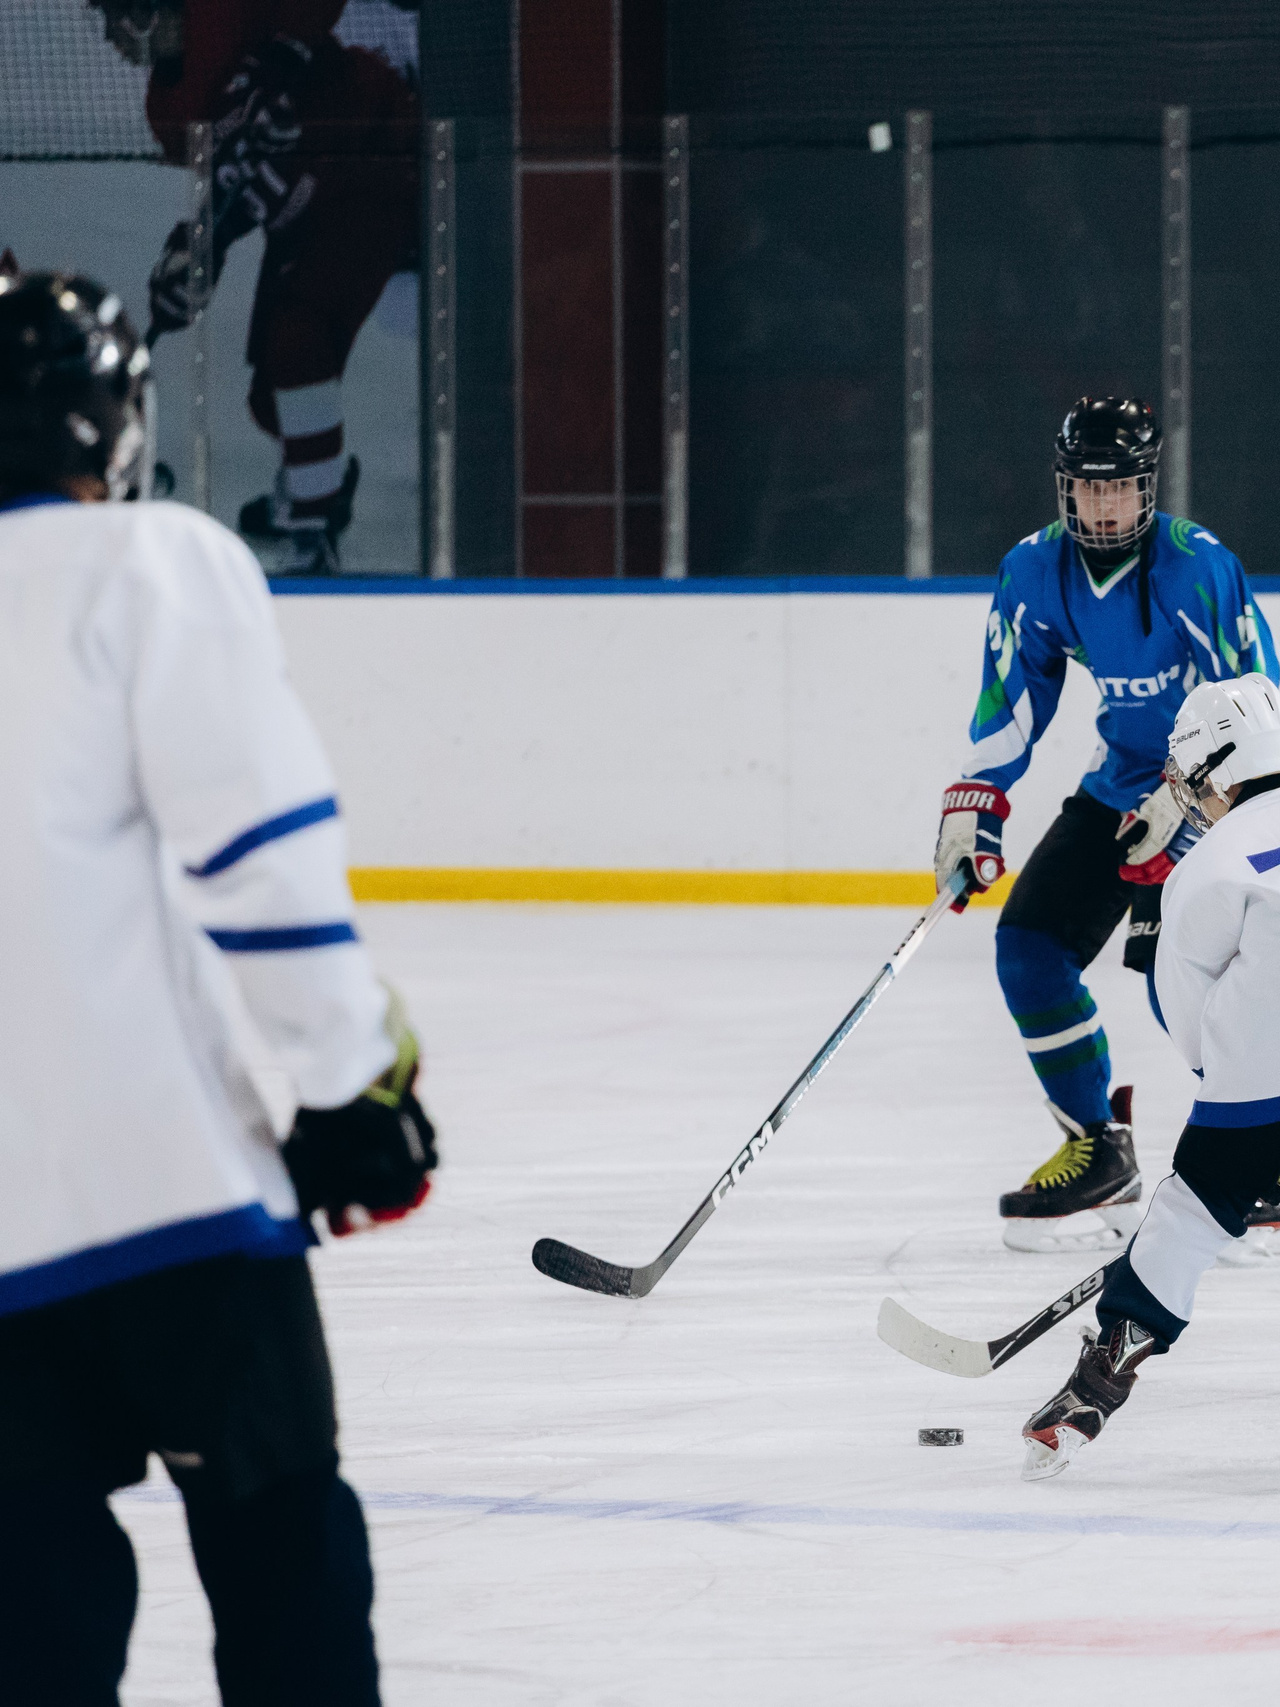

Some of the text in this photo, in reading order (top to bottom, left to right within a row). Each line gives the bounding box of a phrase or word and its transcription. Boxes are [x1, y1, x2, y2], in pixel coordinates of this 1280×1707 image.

[944, 789, 997, 811] RIOR
[711, 1120, 774, 1209] CCM
[1051, 1268, 1104, 1320] S19
